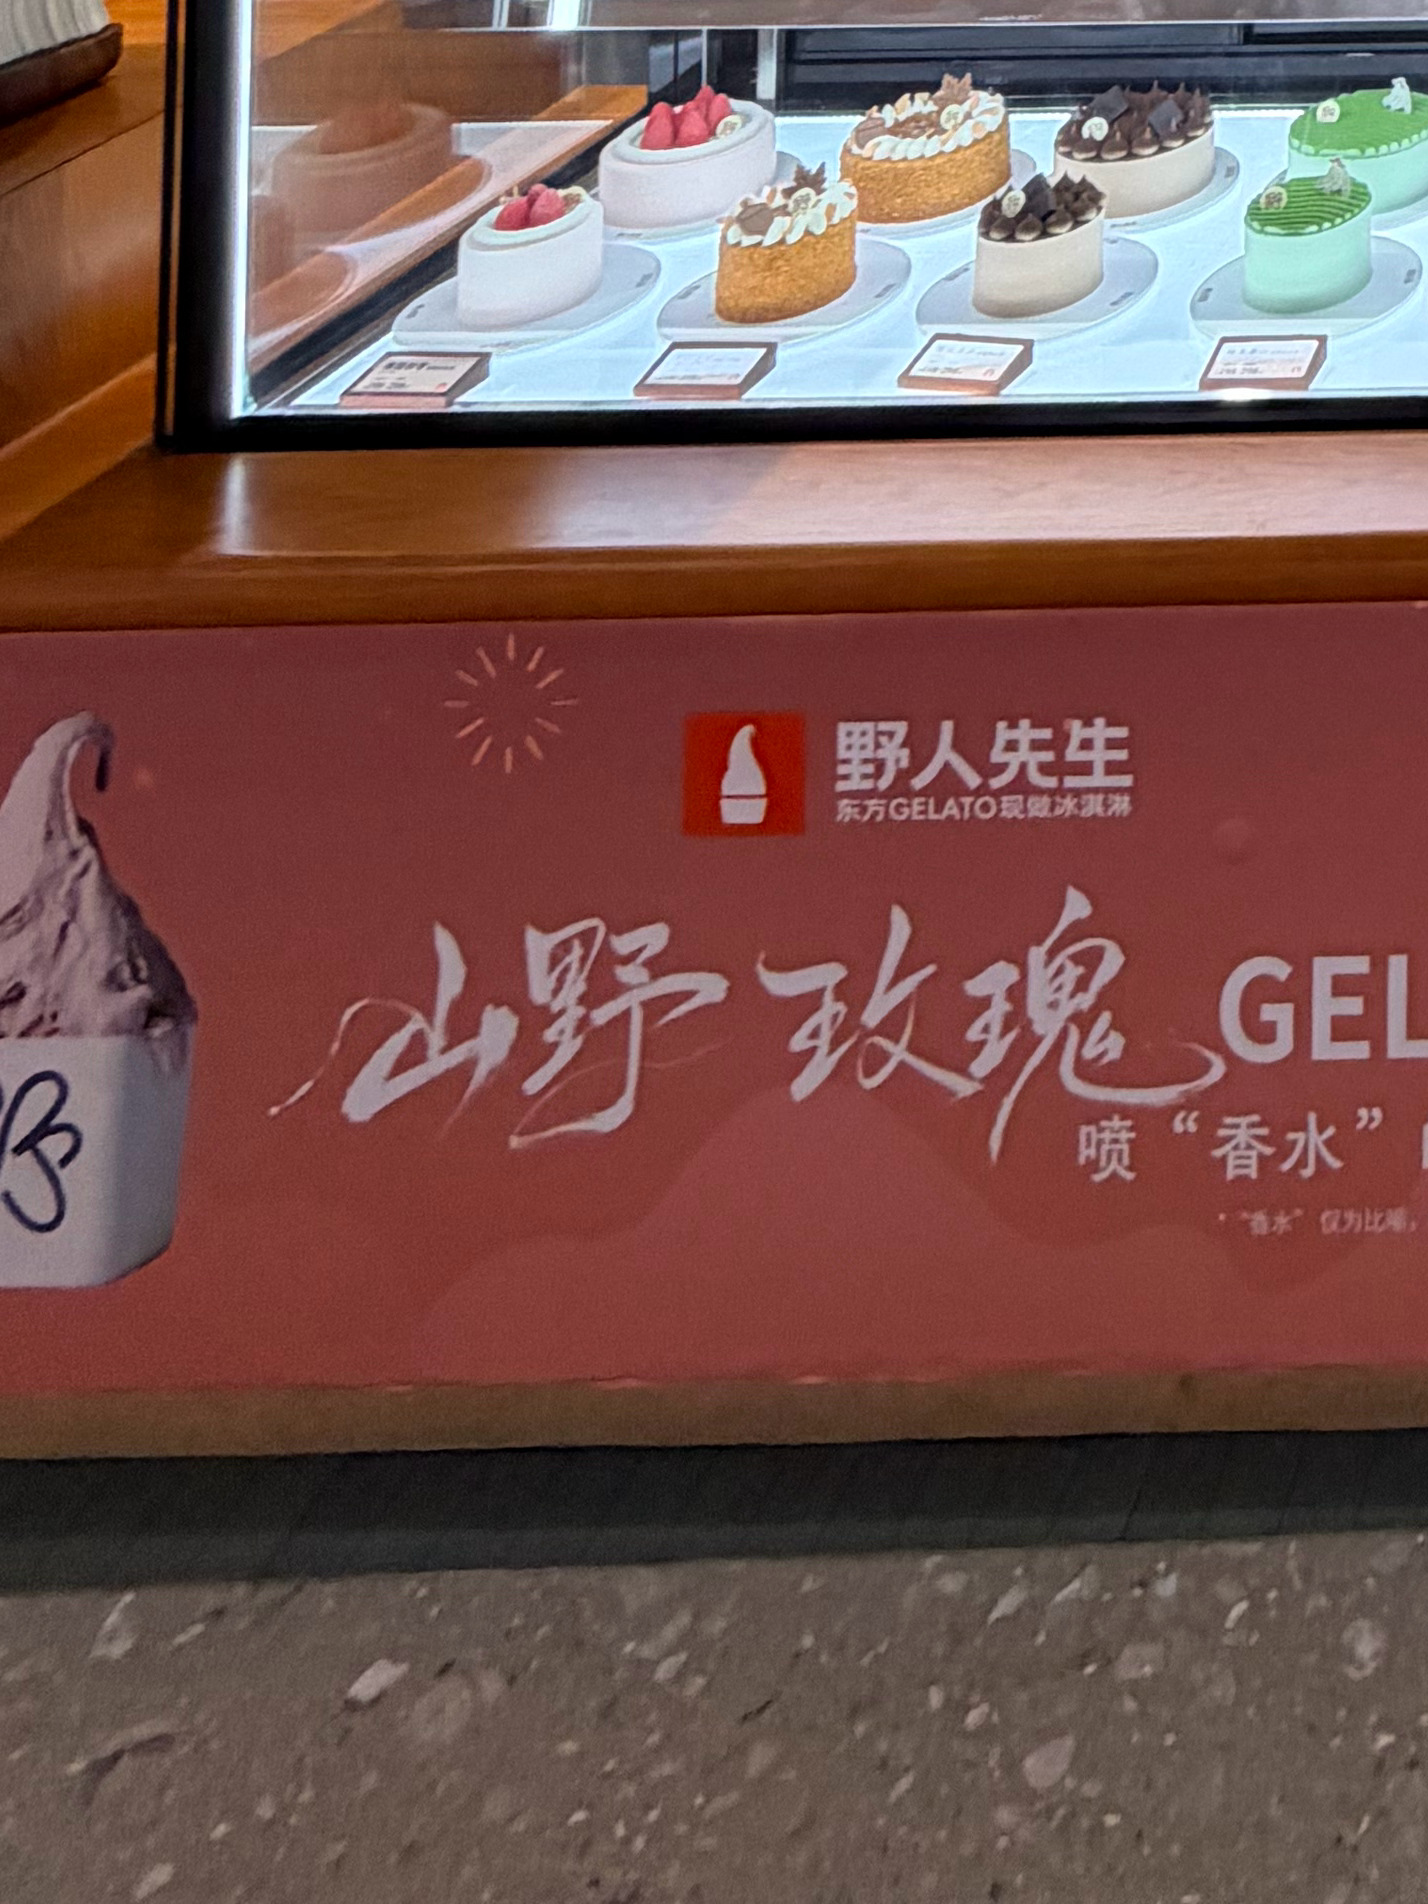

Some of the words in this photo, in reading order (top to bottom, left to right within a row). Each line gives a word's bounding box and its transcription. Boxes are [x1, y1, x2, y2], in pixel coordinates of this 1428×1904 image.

[835, 717, 1134, 793] 野人先生
[835, 793, 1133, 823] 东方GELATO现做冰淇淋
[268, 884, 1226, 1165] 山野玫瑰
